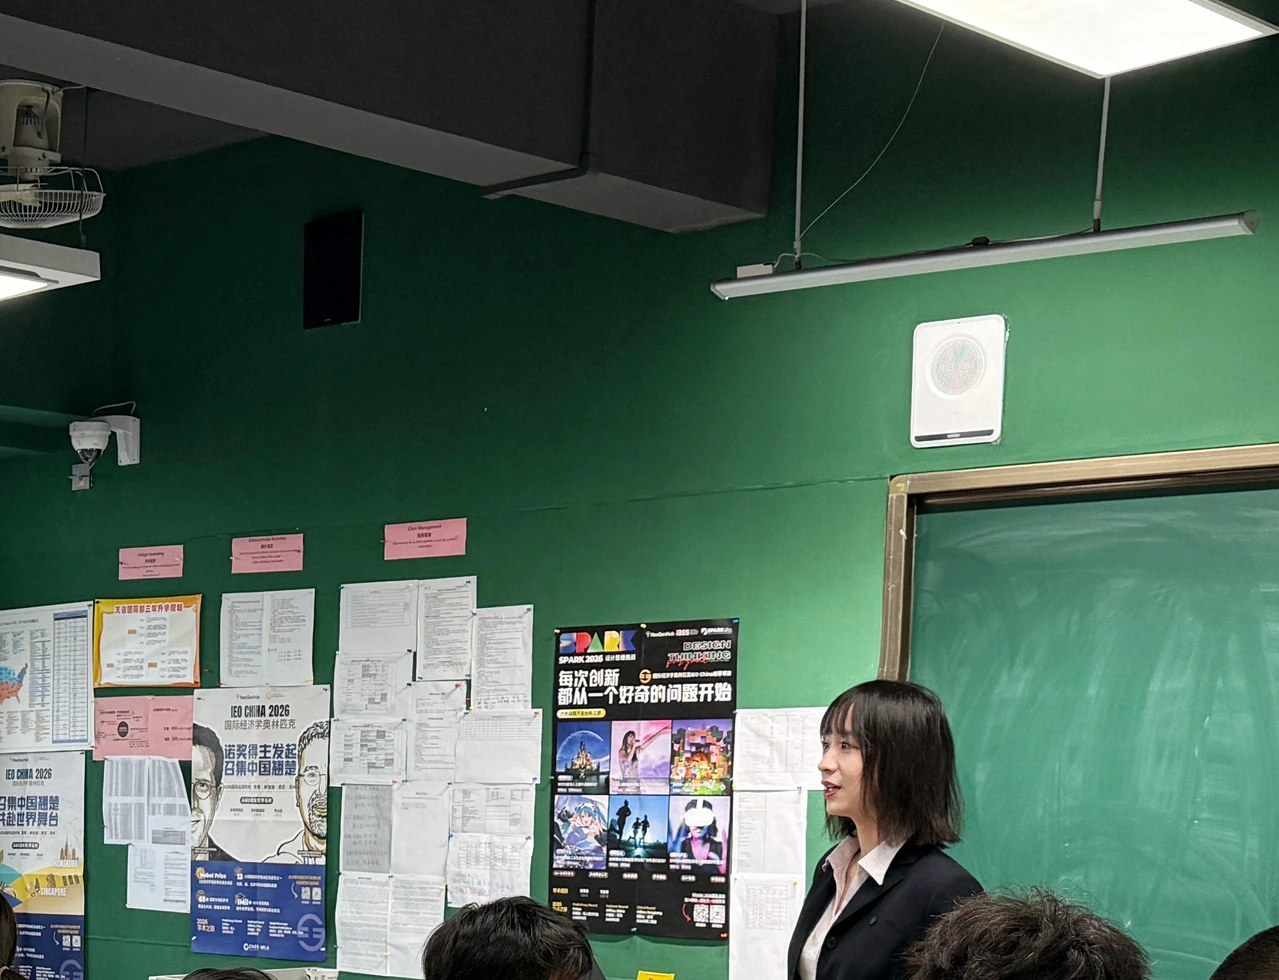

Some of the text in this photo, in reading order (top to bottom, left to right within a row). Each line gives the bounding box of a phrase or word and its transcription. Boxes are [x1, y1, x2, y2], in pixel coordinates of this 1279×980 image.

[560, 629, 637, 654] SPARK
[683, 640, 732, 651] DESIGN
[558, 655, 584, 664] SPARK
[585, 654, 604, 663] 2026
[667, 650, 732, 661] THINKING
[558, 668, 620, 687] 每次创新
[557, 682, 732, 706] 都从一个好奇的问题开始
[230, 703, 290, 718] IEO CHINA 2026
[224, 718, 297, 731] 国际经济学奥林匹克
[224, 743, 297, 760] 诺奖得主发起
[5, 768, 15, 780] IEO
[35, 767, 53, 780] 2026
[224, 760, 297, 777] 召集中国翘楚
